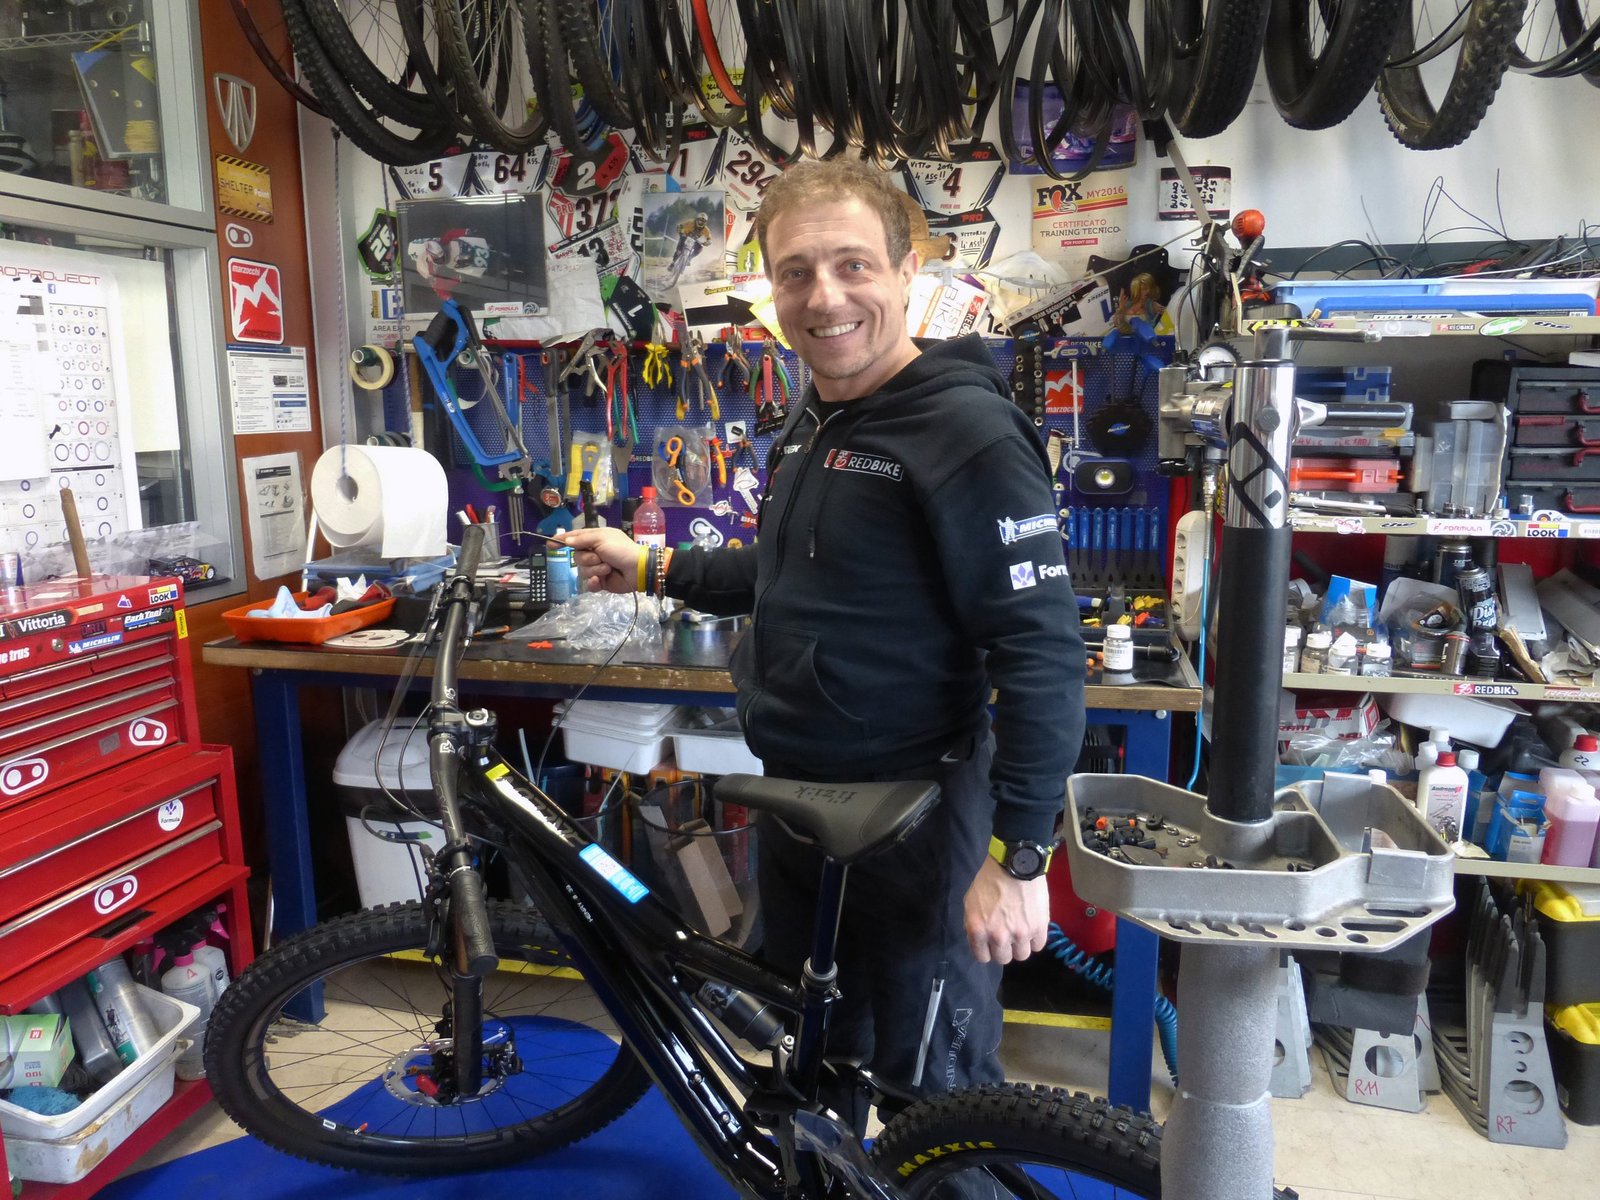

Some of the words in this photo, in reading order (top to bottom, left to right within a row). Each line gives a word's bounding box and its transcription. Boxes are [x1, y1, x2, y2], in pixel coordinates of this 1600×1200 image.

[428, 162, 443, 192] 5
[494, 154, 526, 184] 64
[577, 161, 596, 191] 2
[219, 178, 254, 195] SHELTER
[942, 167, 963, 198] 4
[1036, 182, 1083, 207] FOX
[1086, 185, 1124, 199] MY2016
[556, 203, 575, 217] PRO
[961, 214, 984, 222] PRO
[1040, 228, 1080, 238] TRAINING
[1082, 226, 1120, 235] TECNICO
[1052, 218, 1107, 229] CERTIFICATO
[848, 456, 902, 477] REDBIKE
[1444, 525, 1482, 533] FORMULA
[1527, 529, 1556, 538] LOOK
[150, 593, 170, 604] LOOK
[18, 613, 66, 633] Vittoria
[82, 634, 121, 649] MICHELIN
[1496, 1116, 1517, 1133] R7
[896, 1141, 997, 1177] MAXXIS
